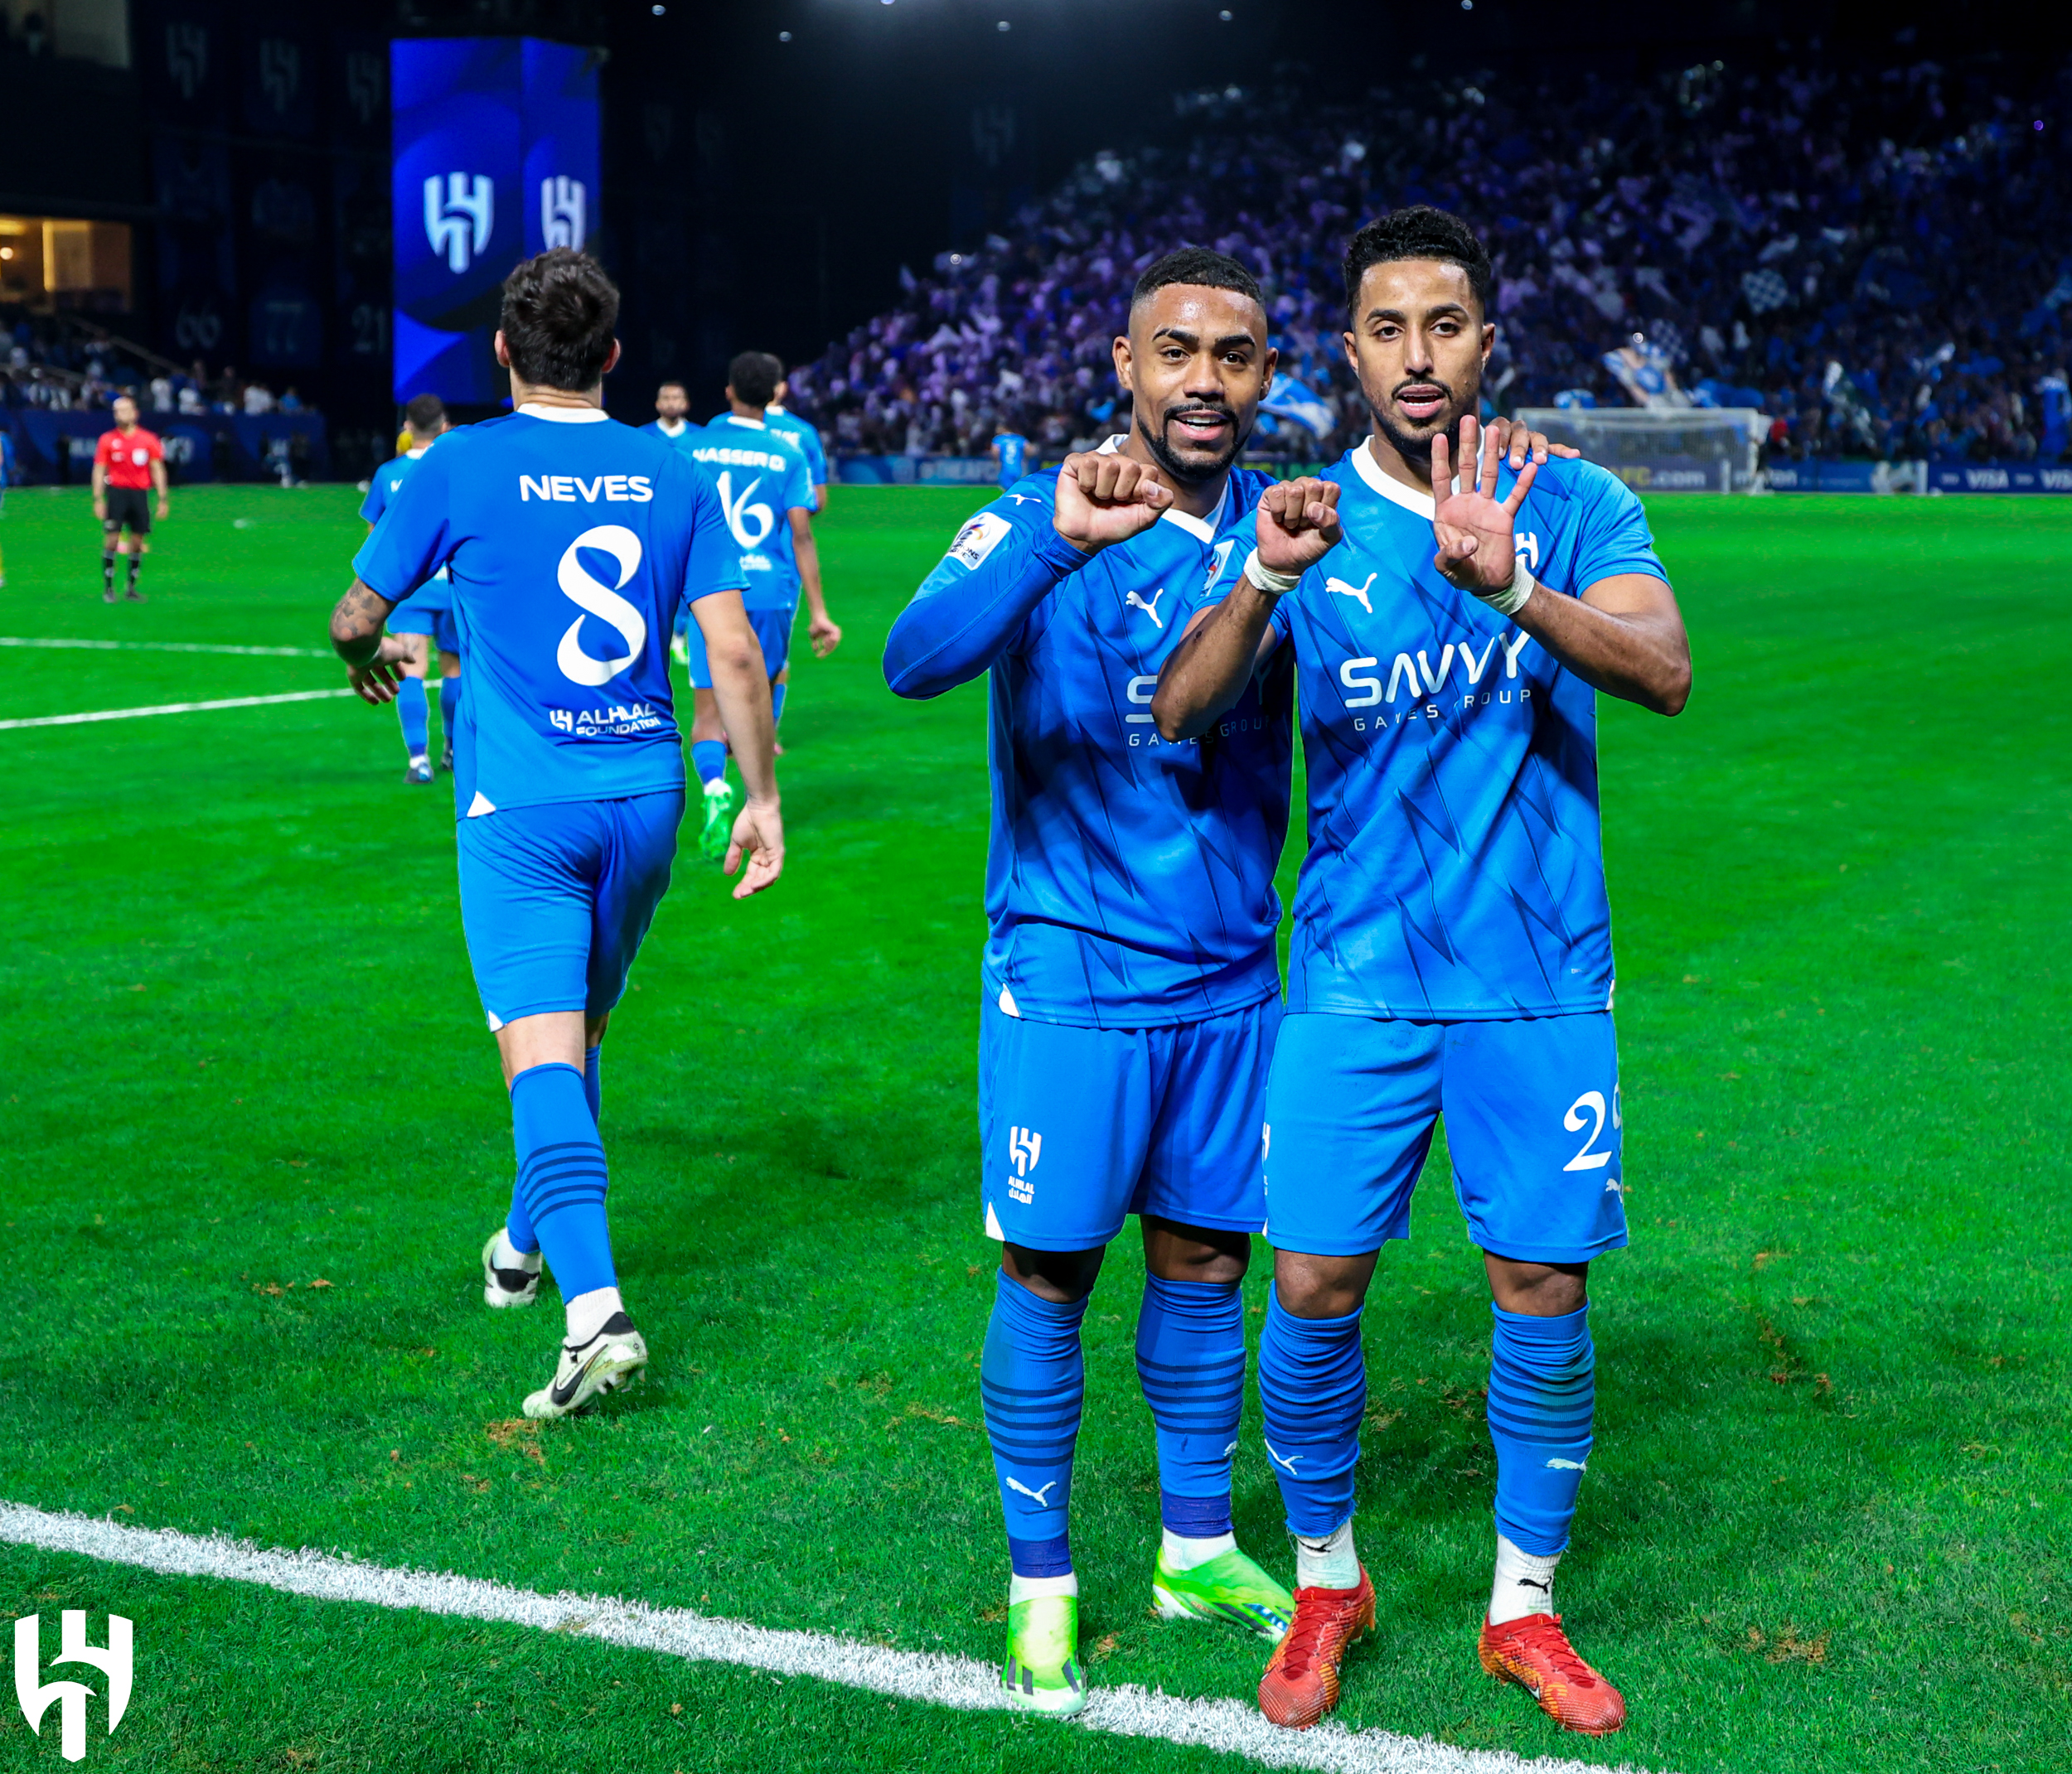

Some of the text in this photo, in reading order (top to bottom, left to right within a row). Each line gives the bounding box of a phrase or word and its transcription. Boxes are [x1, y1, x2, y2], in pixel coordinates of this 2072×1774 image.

[519, 475, 654, 503] NEVES
[1965, 468, 2009, 490] VISA
[2039, 468, 2072, 490] VIS
[716, 471, 774, 549] 16
[556, 524, 646, 687] 8
[1339, 630, 1532, 708] SAVVY
[1454, 689, 1532, 710] ROUP
[576, 716, 662, 737] FOUNDATION
[1129, 731, 1214, 747] GAES
[1562, 1082, 1623, 1172] 2
